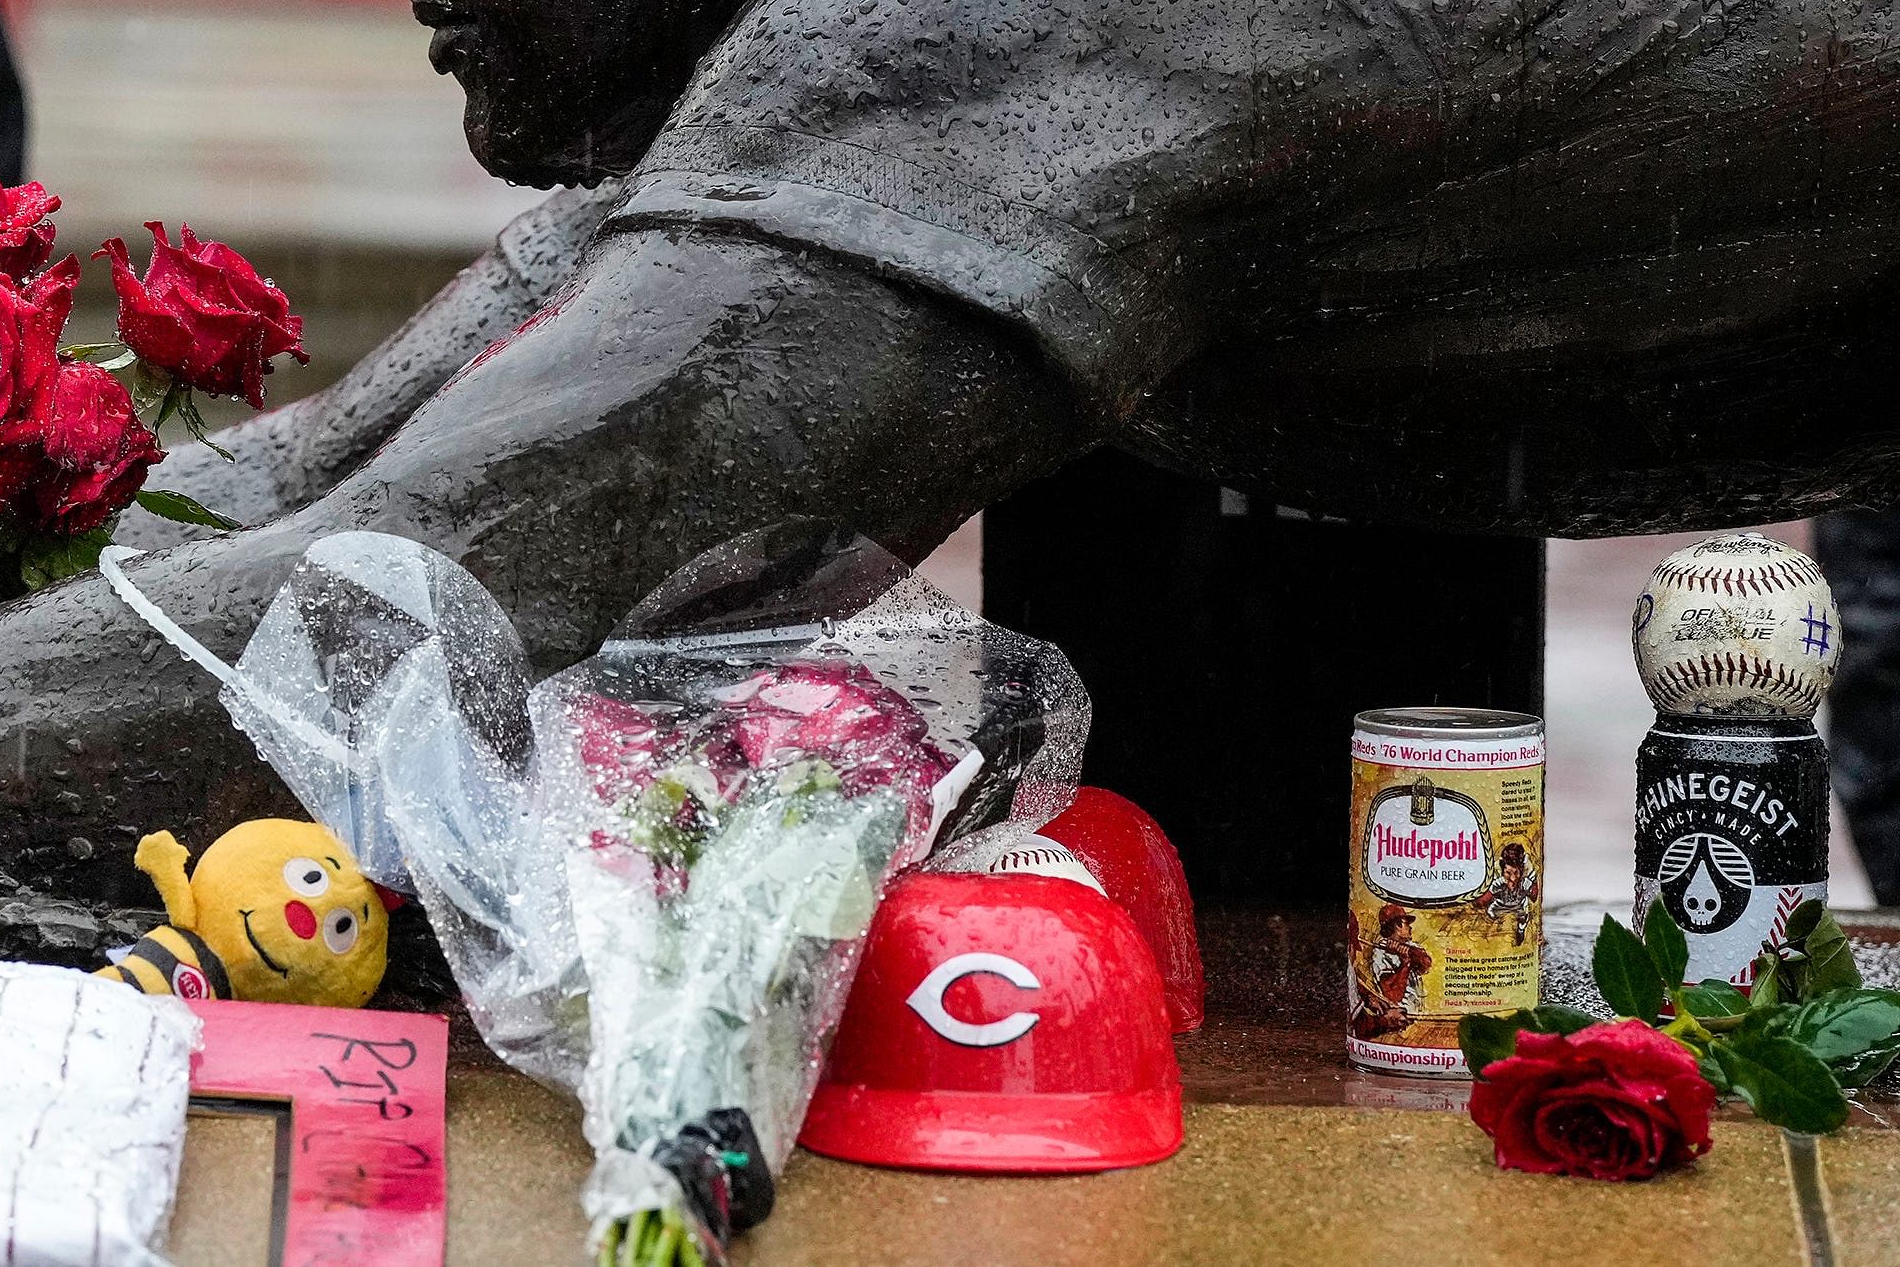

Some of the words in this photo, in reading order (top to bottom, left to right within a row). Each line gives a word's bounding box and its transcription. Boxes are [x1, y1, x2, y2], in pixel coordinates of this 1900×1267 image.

[1379, 743, 1397, 759] '76
[1399, 747, 1442, 762] World
[1445, 748, 1518, 766] Champion
[1519, 745, 1540, 759] Reds
[1637, 772, 1799, 838] RHINEGEIST
[1654, 809, 1694, 840] CINCY
[1714, 811, 1762, 846] MADE
[1372, 822, 1479, 869] Hudepohl
[1380, 865, 1402, 879] PURE
[1404, 868, 1438, 881] GRAIN
[1441, 870, 1466, 881] BEER
[1444, 966, 1473, 974] slugged
[1487, 964, 1509, 972] homers
[1445, 956, 1459, 964] The
[1444, 981, 1470, 989] second
[905, 951, 1042, 1048] C
[1357, 1042, 1457, 1069] Championship
[309, 1030, 419, 1121] RIP
